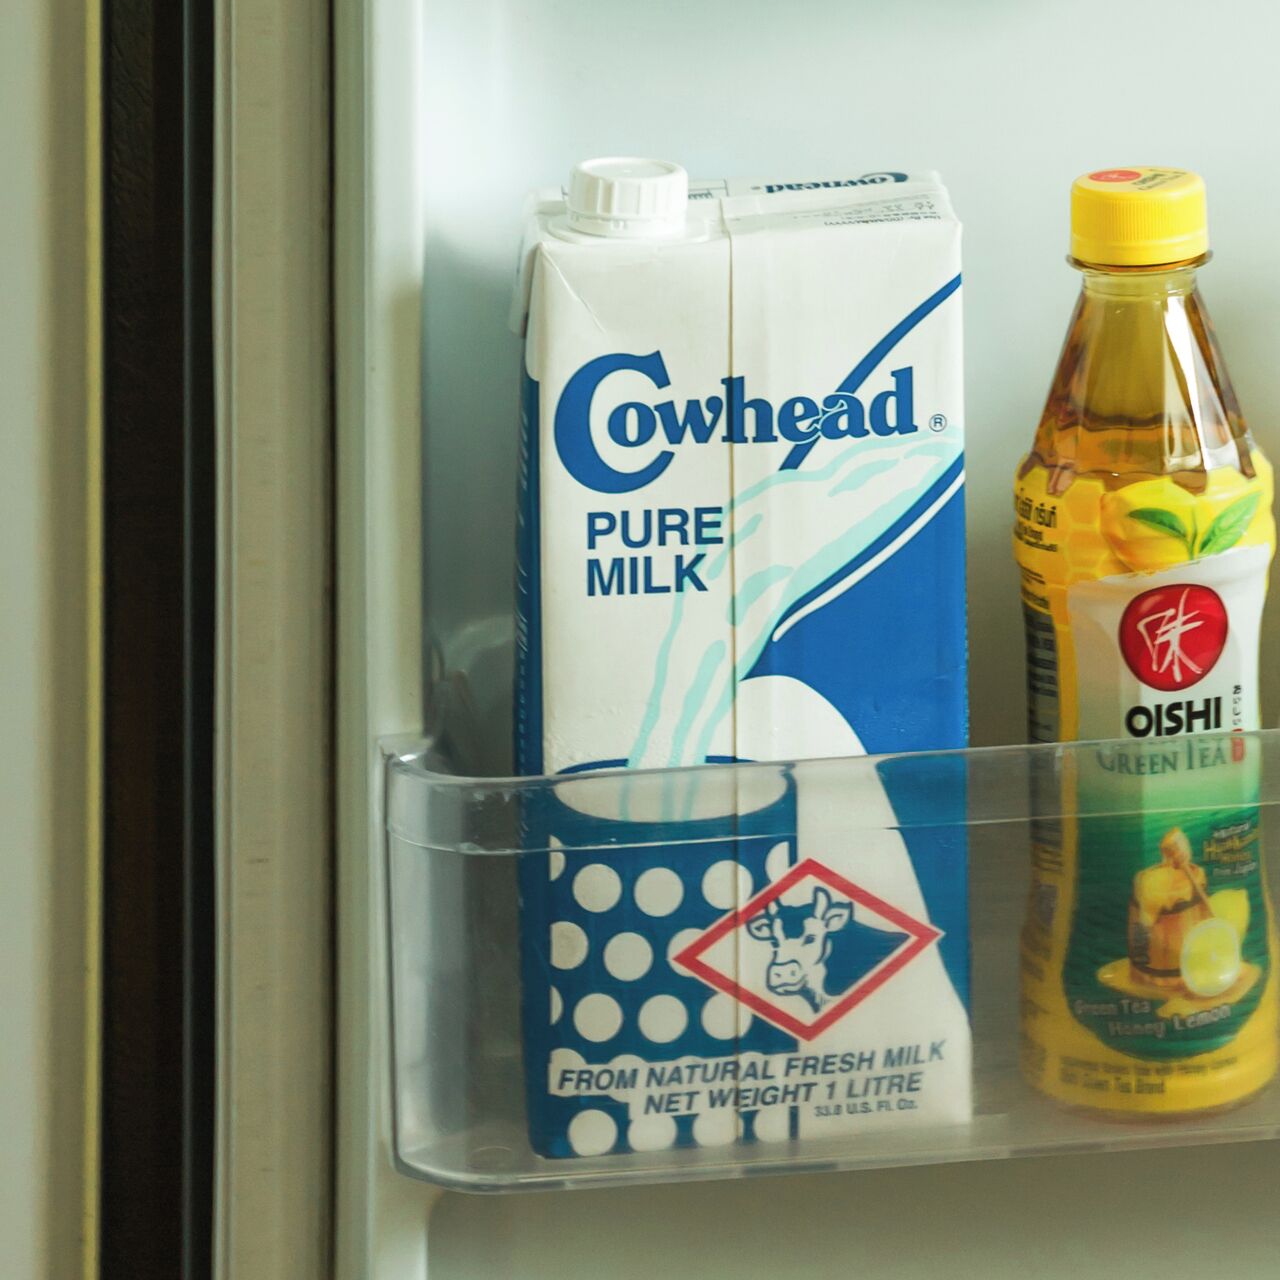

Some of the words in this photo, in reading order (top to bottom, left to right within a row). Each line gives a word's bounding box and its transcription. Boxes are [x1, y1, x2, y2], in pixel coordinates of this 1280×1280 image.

[553, 350, 918, 494] Cowhead
[586, 506, 724, 551] PURE
[586, 553, 709, 597] MILK
[1125, 696, 1222, 738] OISHI
[1096, 742, 1178, 776] GREEN
[1185, 739, 1228, 771] TEA
[1120, 999, 1151, 1015] Tea
[1172, 1004, 1232, 1031] Lemon
[558, 1068, 638, 1091] FROM
[646, 1056, 776, 1089] NATURAL
[784, 1050, 876, 1079] FRESH
[883, 1039, 948, 1068] MILK
[643, 1090, 701, 1115] NET
[708, 1080, 818, 1110] WEIGHT
[825, 1079, 836, 1101] 1
[846, 1071, 924, 1099] LITRE
[814, 1103, 843, 1118] 33.8
[846, 1100, 874, 1115] U.S.
